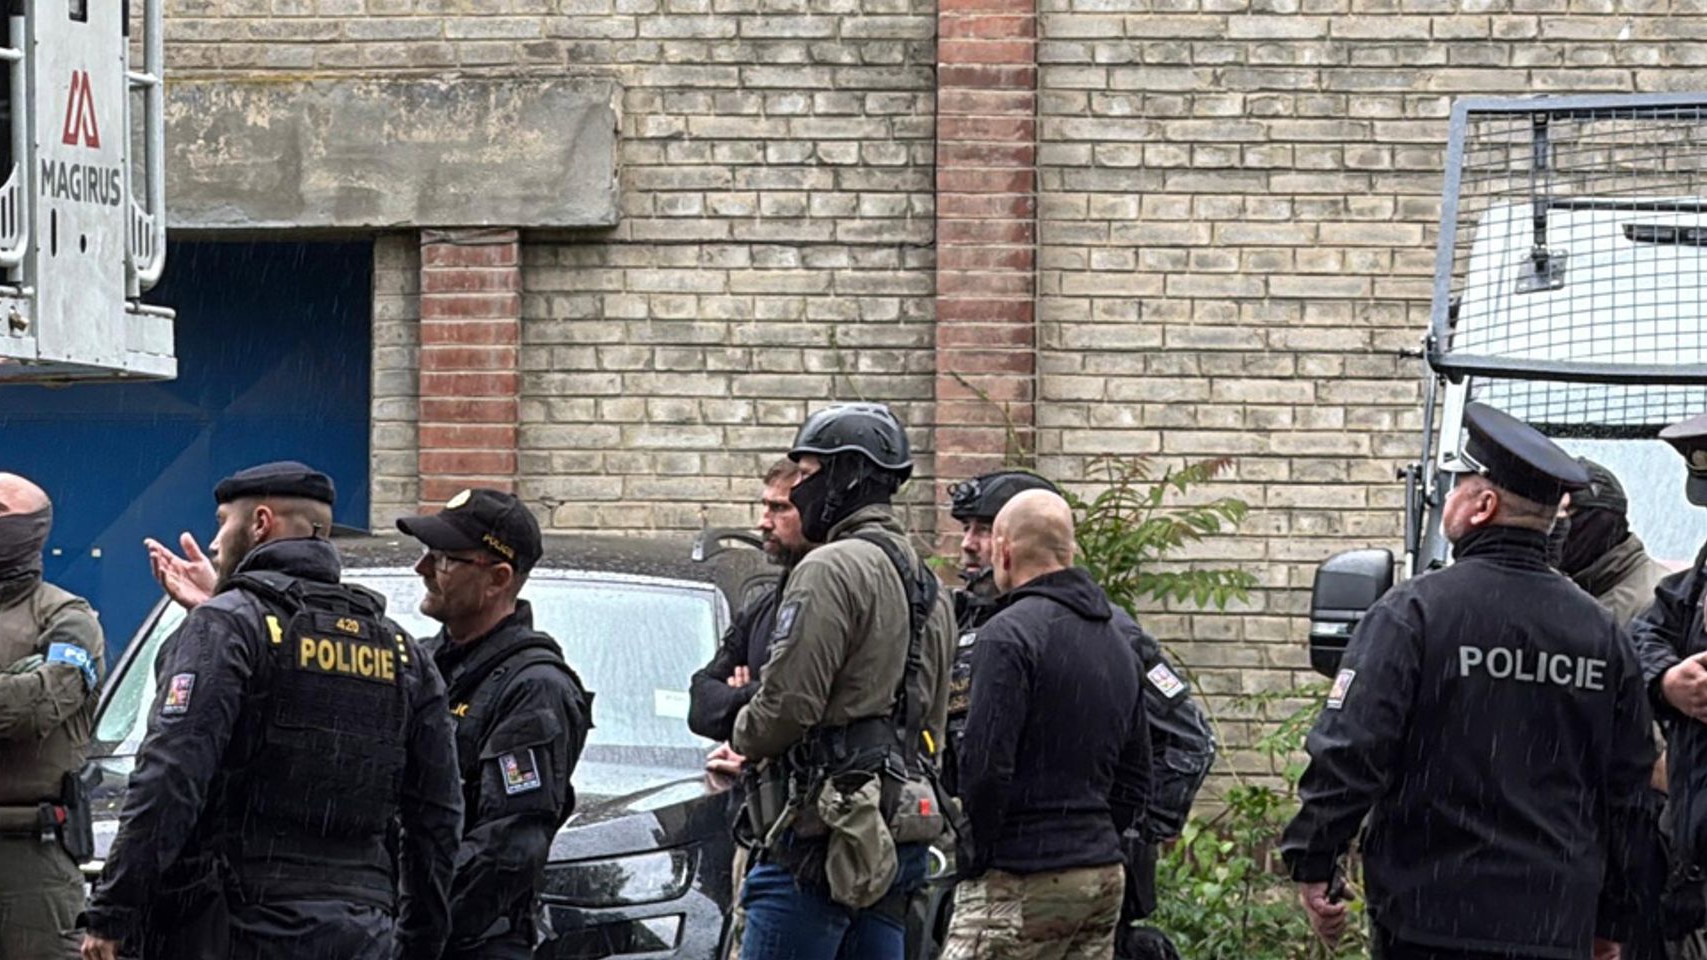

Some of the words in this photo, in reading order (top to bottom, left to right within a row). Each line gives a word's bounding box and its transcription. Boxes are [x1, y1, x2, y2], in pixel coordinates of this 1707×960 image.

[41, 158, 121, 207] MAGIRUS
[300, 637, 394, 680] POLICIE
[1459, 645, 1607, 690] POLICIE
